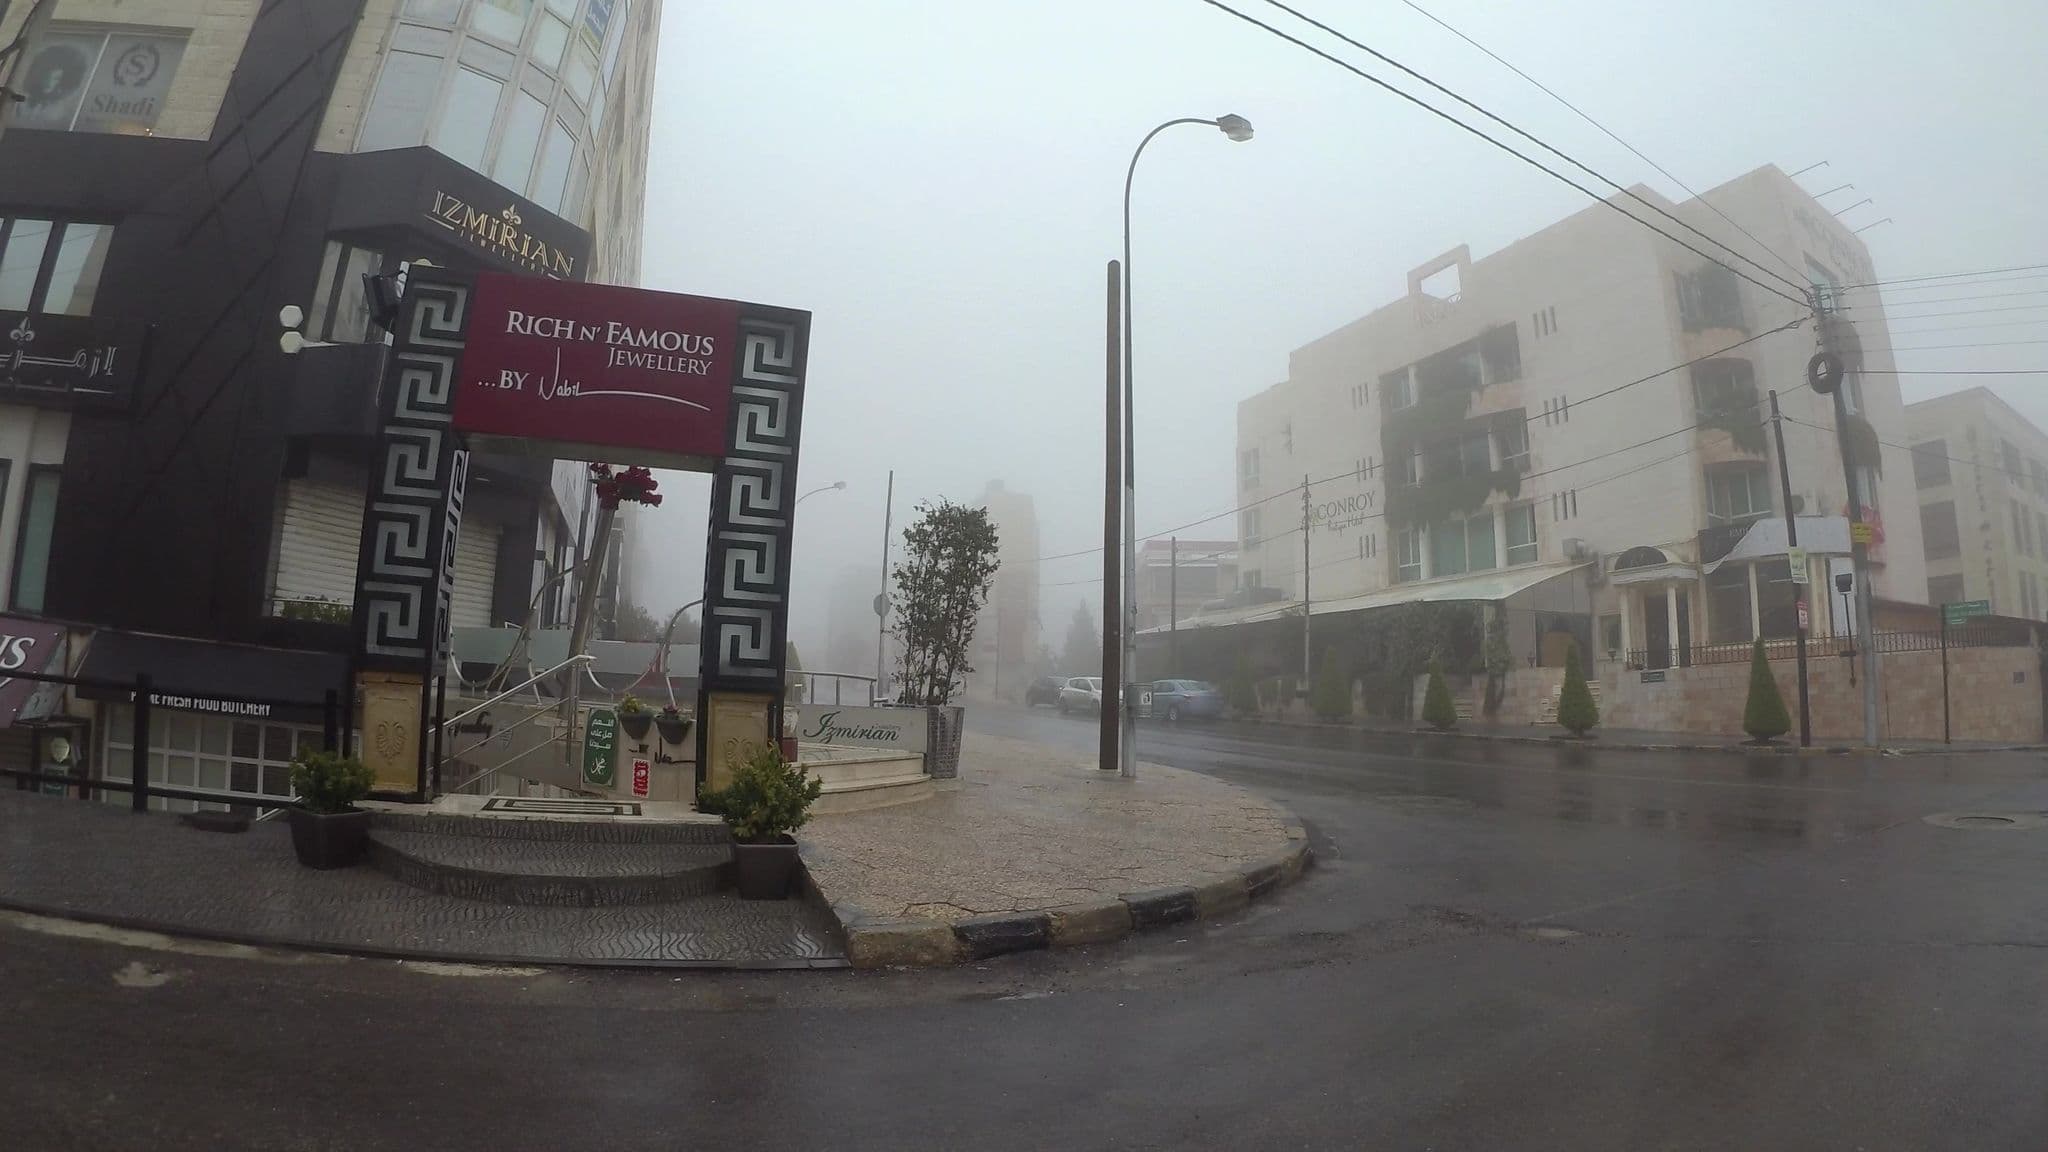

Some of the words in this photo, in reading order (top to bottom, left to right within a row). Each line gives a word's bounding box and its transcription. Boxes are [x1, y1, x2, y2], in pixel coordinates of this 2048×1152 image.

[91, 94, 156, 117] Shadi
[505, 310, 574, 341] RICH
[605, 321, 715, 356] FAMOUS
[607, 347, 713, 376] JEWELLERY
[1316, 490, 1376, 520] CONROY
[221, 700, 271, 716] BUTCHERY
[803, 711, 900, 744] Izmirian
